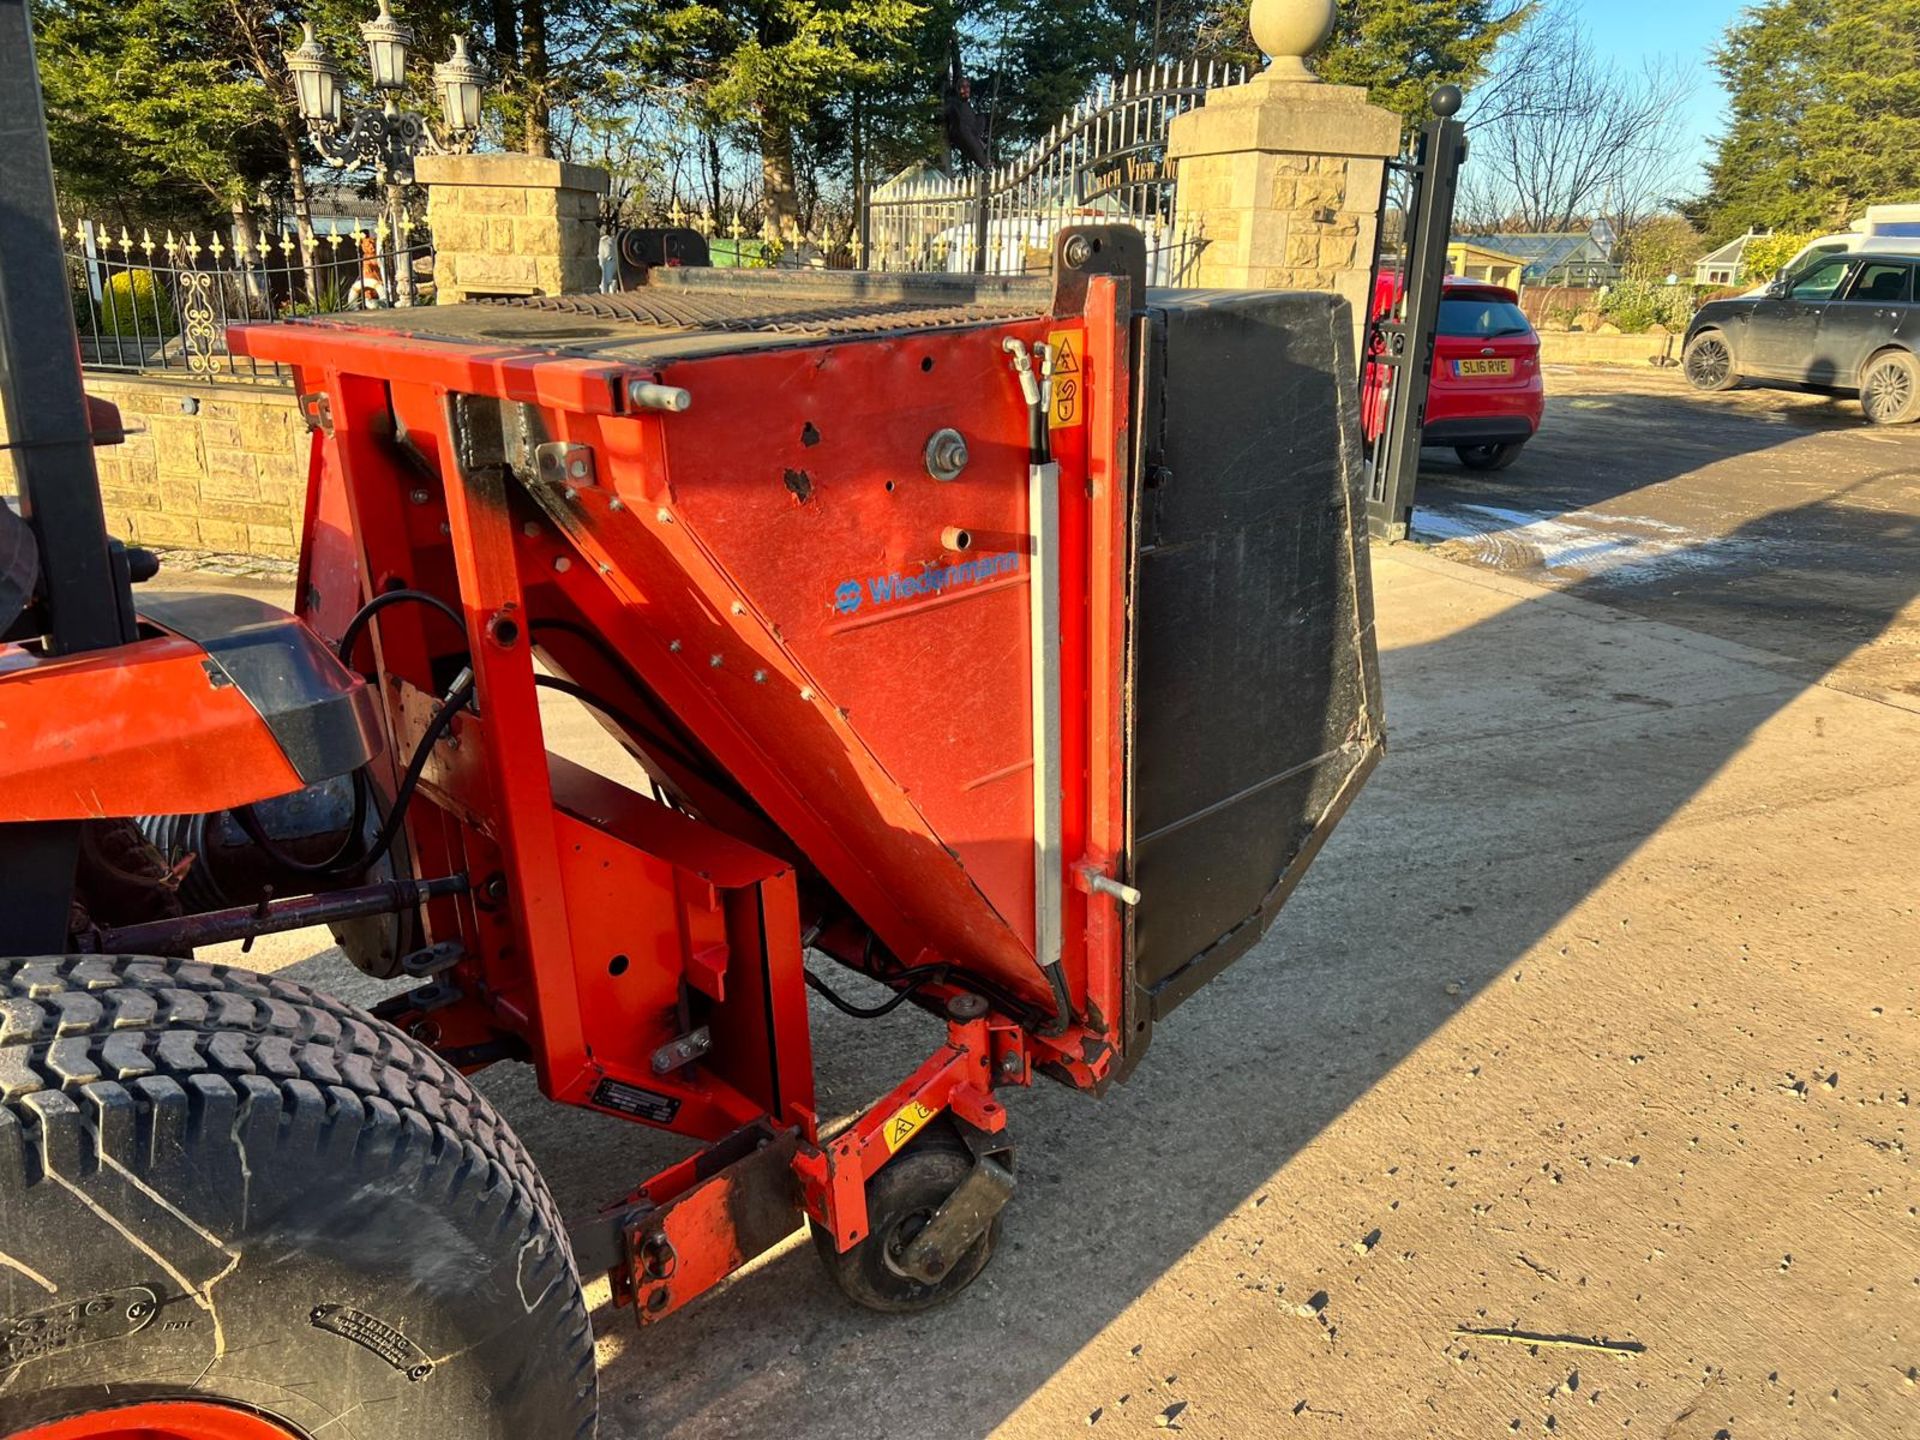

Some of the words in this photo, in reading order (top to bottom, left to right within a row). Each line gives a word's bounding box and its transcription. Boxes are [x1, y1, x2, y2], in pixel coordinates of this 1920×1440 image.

[1127, 155, 1156, 182] VIEW
[1463, 361, 1486, 373] SL16
[1487, 360, 1508, 373] RVE
[869, 551, 1019, 605] Wiedenmann
[347, 1311, 408, 1349] WARNING
